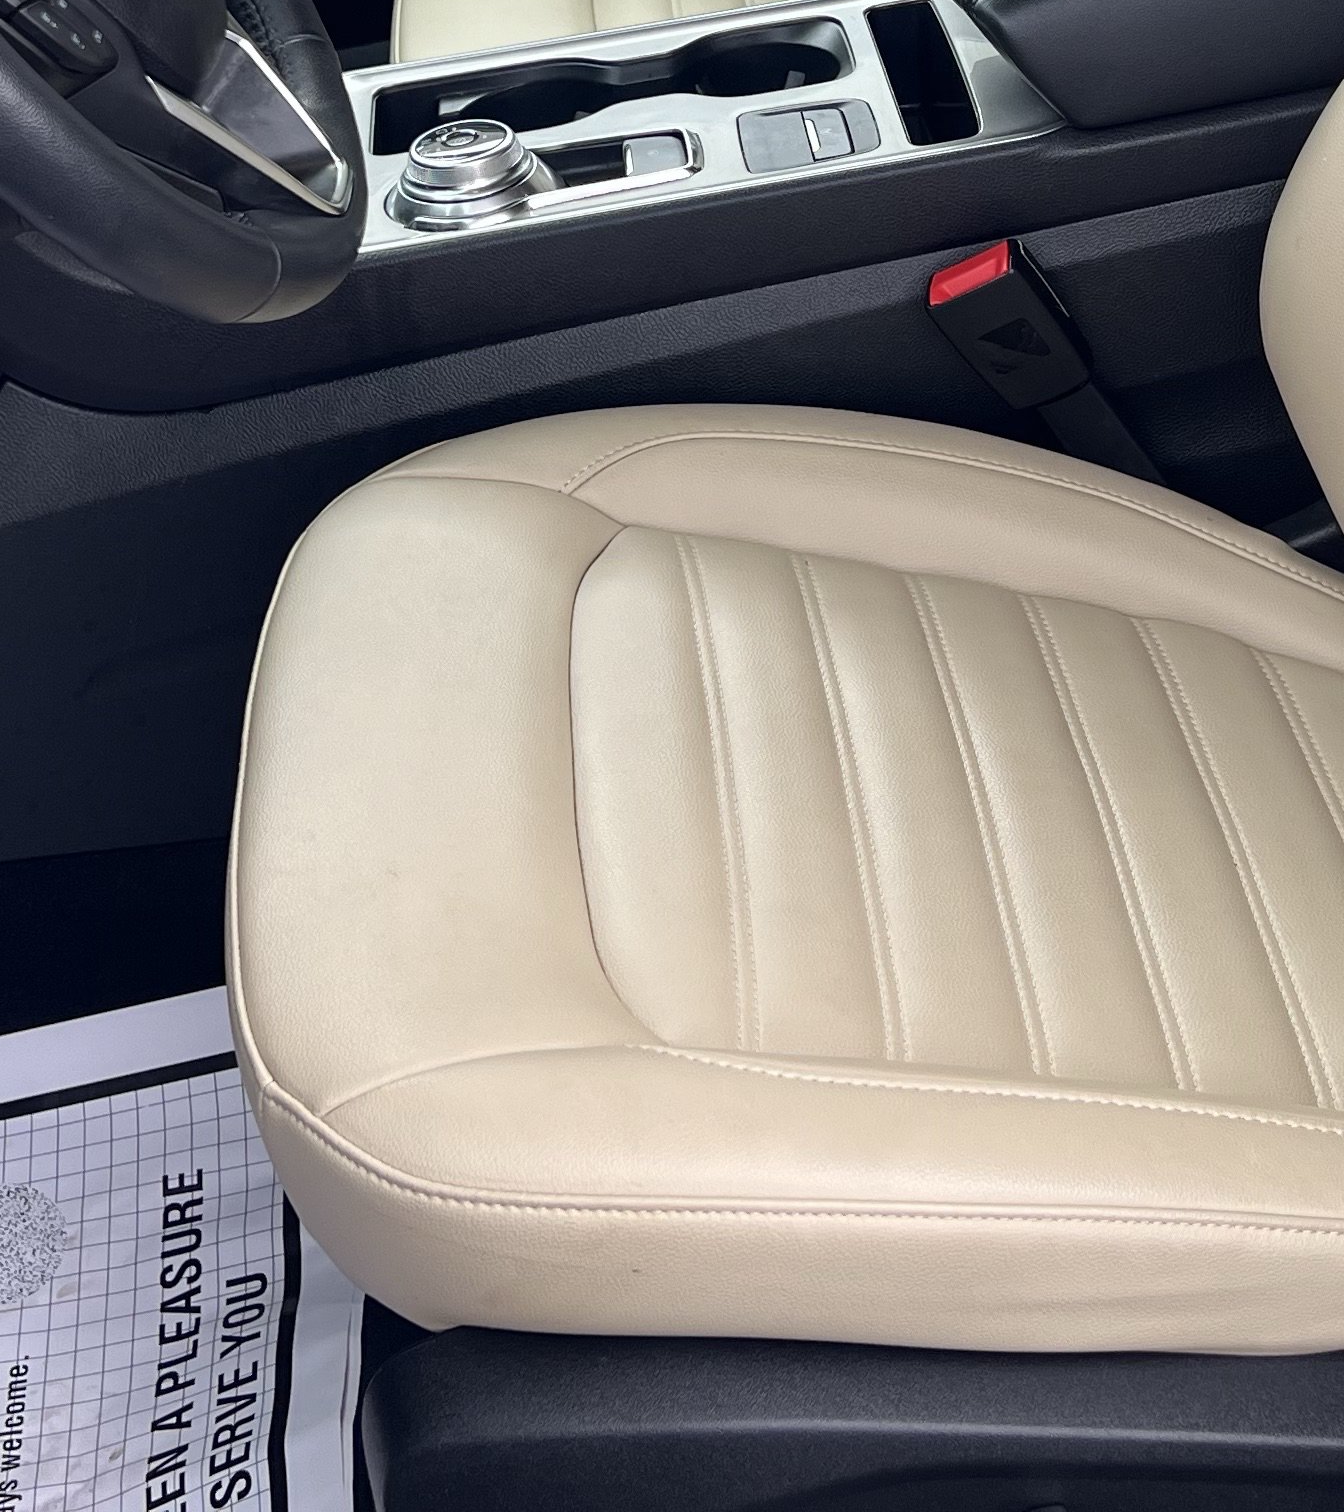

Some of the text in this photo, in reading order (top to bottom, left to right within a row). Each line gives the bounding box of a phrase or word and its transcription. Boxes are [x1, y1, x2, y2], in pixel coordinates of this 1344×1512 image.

[154, 1167, 204, 1398] PLEASURE
[0, 1354, 30, 1473] welcome.
[151, 1402, 194, 1433] A
[209, 1271, 268, 1509] SERVE YOU
